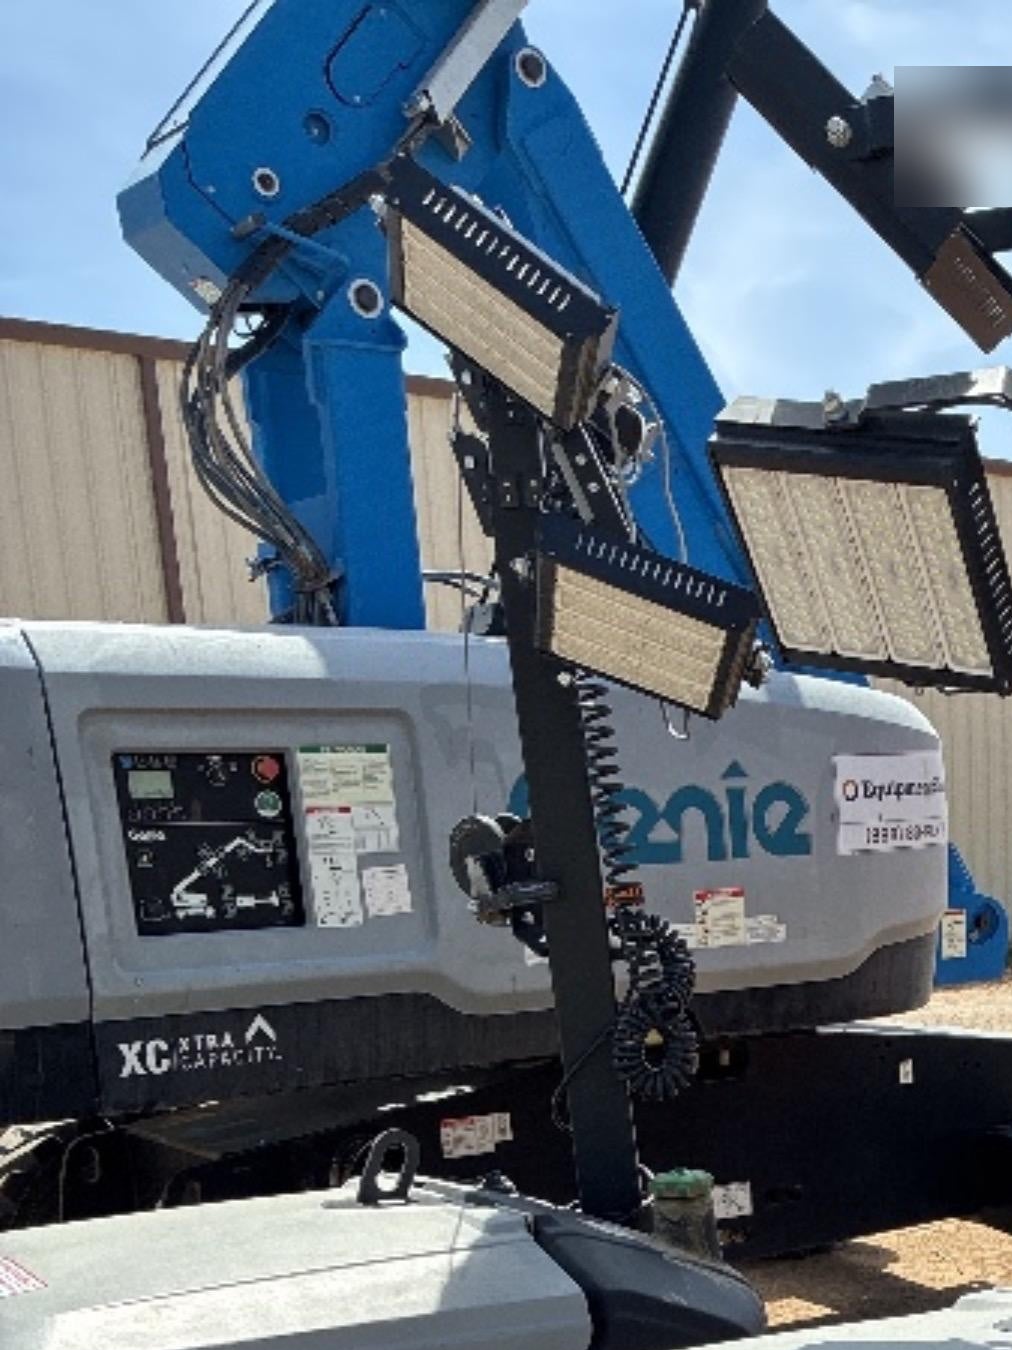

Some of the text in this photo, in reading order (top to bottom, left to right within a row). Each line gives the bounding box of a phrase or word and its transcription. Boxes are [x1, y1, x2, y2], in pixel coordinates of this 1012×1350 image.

[508, 760, 812, 866] enie
[117, 1039, 171, 1078] XC
[179, 1031, 235, 1053] XTRA
